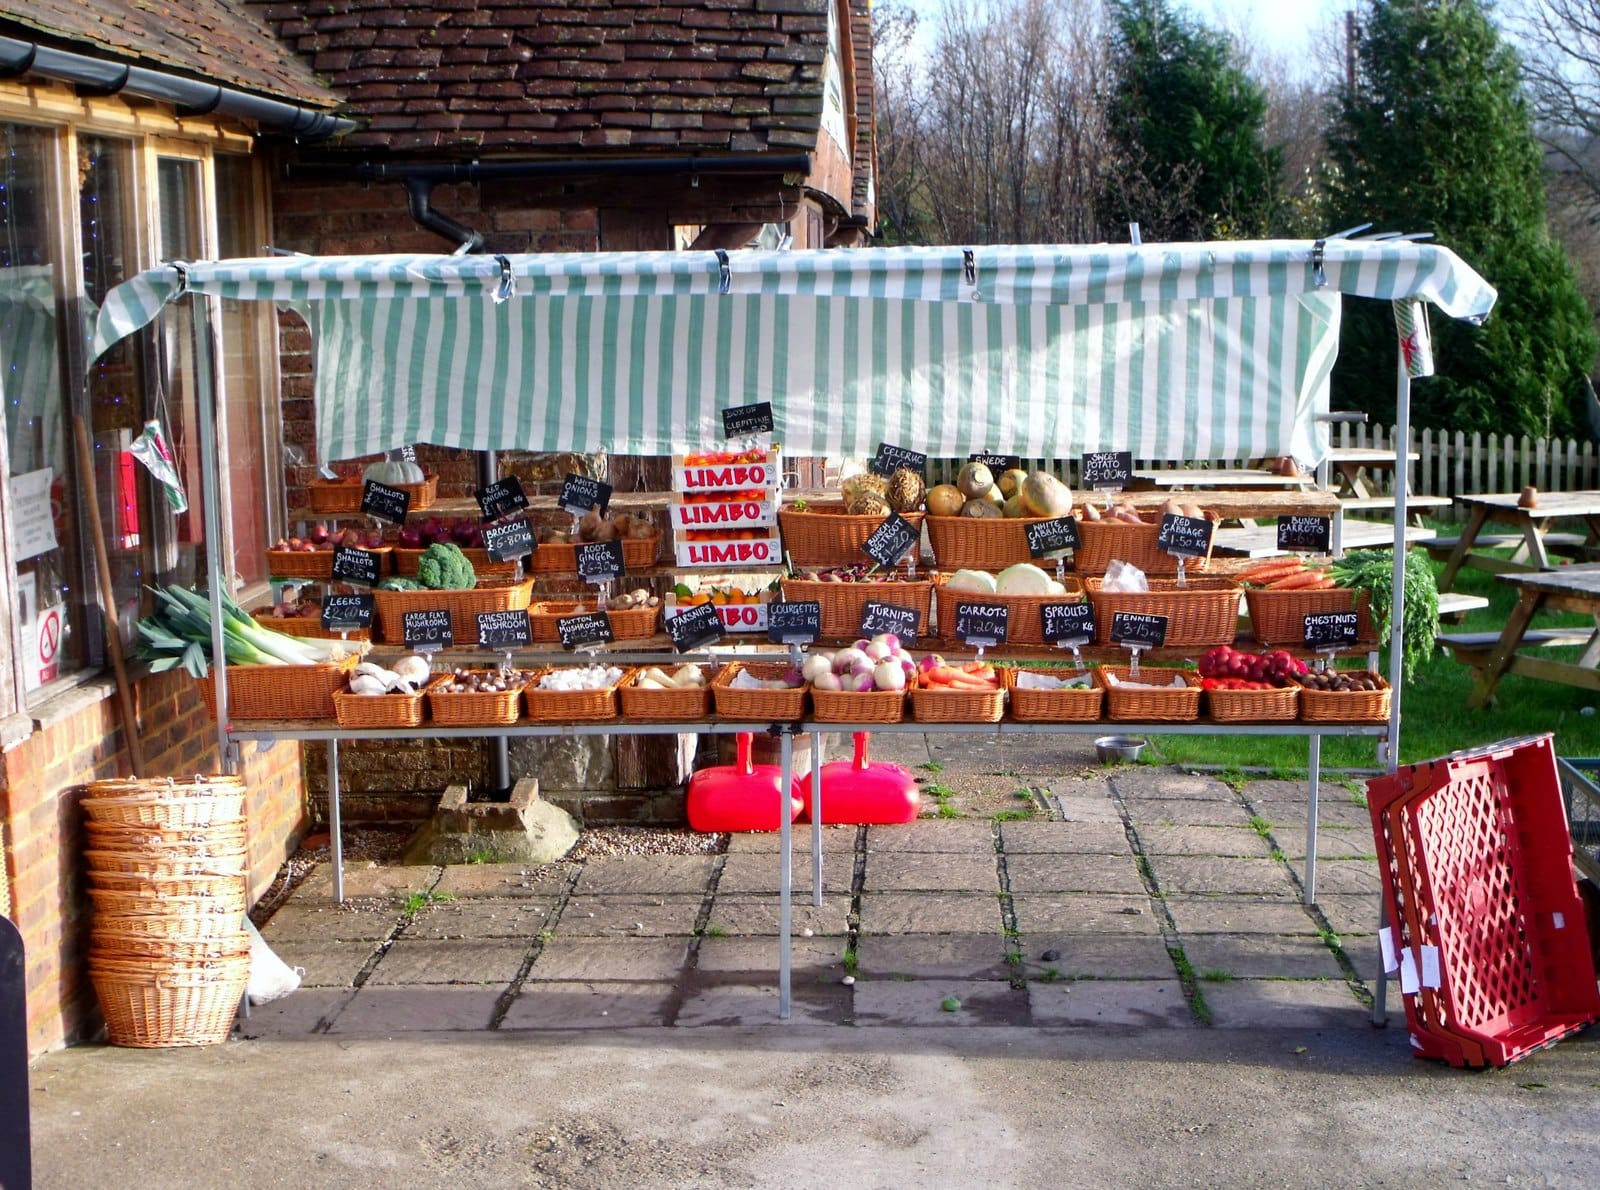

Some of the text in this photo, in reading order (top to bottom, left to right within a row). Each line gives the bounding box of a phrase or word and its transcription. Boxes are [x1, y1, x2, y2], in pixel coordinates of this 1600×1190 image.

[975, 456, 1006, 466] SWEDE
[1091, 452, 1119, 462] SWEET
[1087, 460, 1120, 469] POTATO
[684, 465, 765, 488] LIMBO
[370, 482, 405, 501] SHALLOTS
[485, 484, 500, 494] RED
[564, 482, 598, 498] ONIONS
[482, 489, 510, 505] ONIONS
[679, 502, 760, 525] LIMBO
[1173, 516, 1190, 527] RED
[1290, 516, 1321, 526] BUNCH
[486, 519, 527, 540] BROCCOLI
[1028, 524, 1070, 540] CABBAGE
[1162, 523, 1203, 537] CABBAGE
[1280, 523, 1325, 534] CARROTS
[869, 518, 904, 557] BEETROOT
[583, 544, 606, 553] ROOT
[688, 542, 769, 564] LIMBO
[337, 552, 374, 567] SHALLOTS
[578, 551, 615, 565] GINGER
[330, 597, 361, 606] LEEKS
[770, 603, 819, 615] COURGETTE
[868, 604, 915, 622] TURNIPS
[959, 605, 1007, 617] CARROTS
[1045, 605, 1089, 618] SPROUTS
[405, 611, 445, 621] LARGE FLAT
[478, 611, 524, 624] CHESTNUT
[560, 615, 592, 626] BUTTON
[672, 604, 712, 628] PARSNIPS
[1115, 613, 1160, 624] FENNEL
[1304, 613, 1357, 626] CHESTNUTS
[406, 619, 448, 628] MUSHROOMS
[480, 619, 527, 631] MUSHROOM
[558, 619, 605, 635] MUSHROOMS
